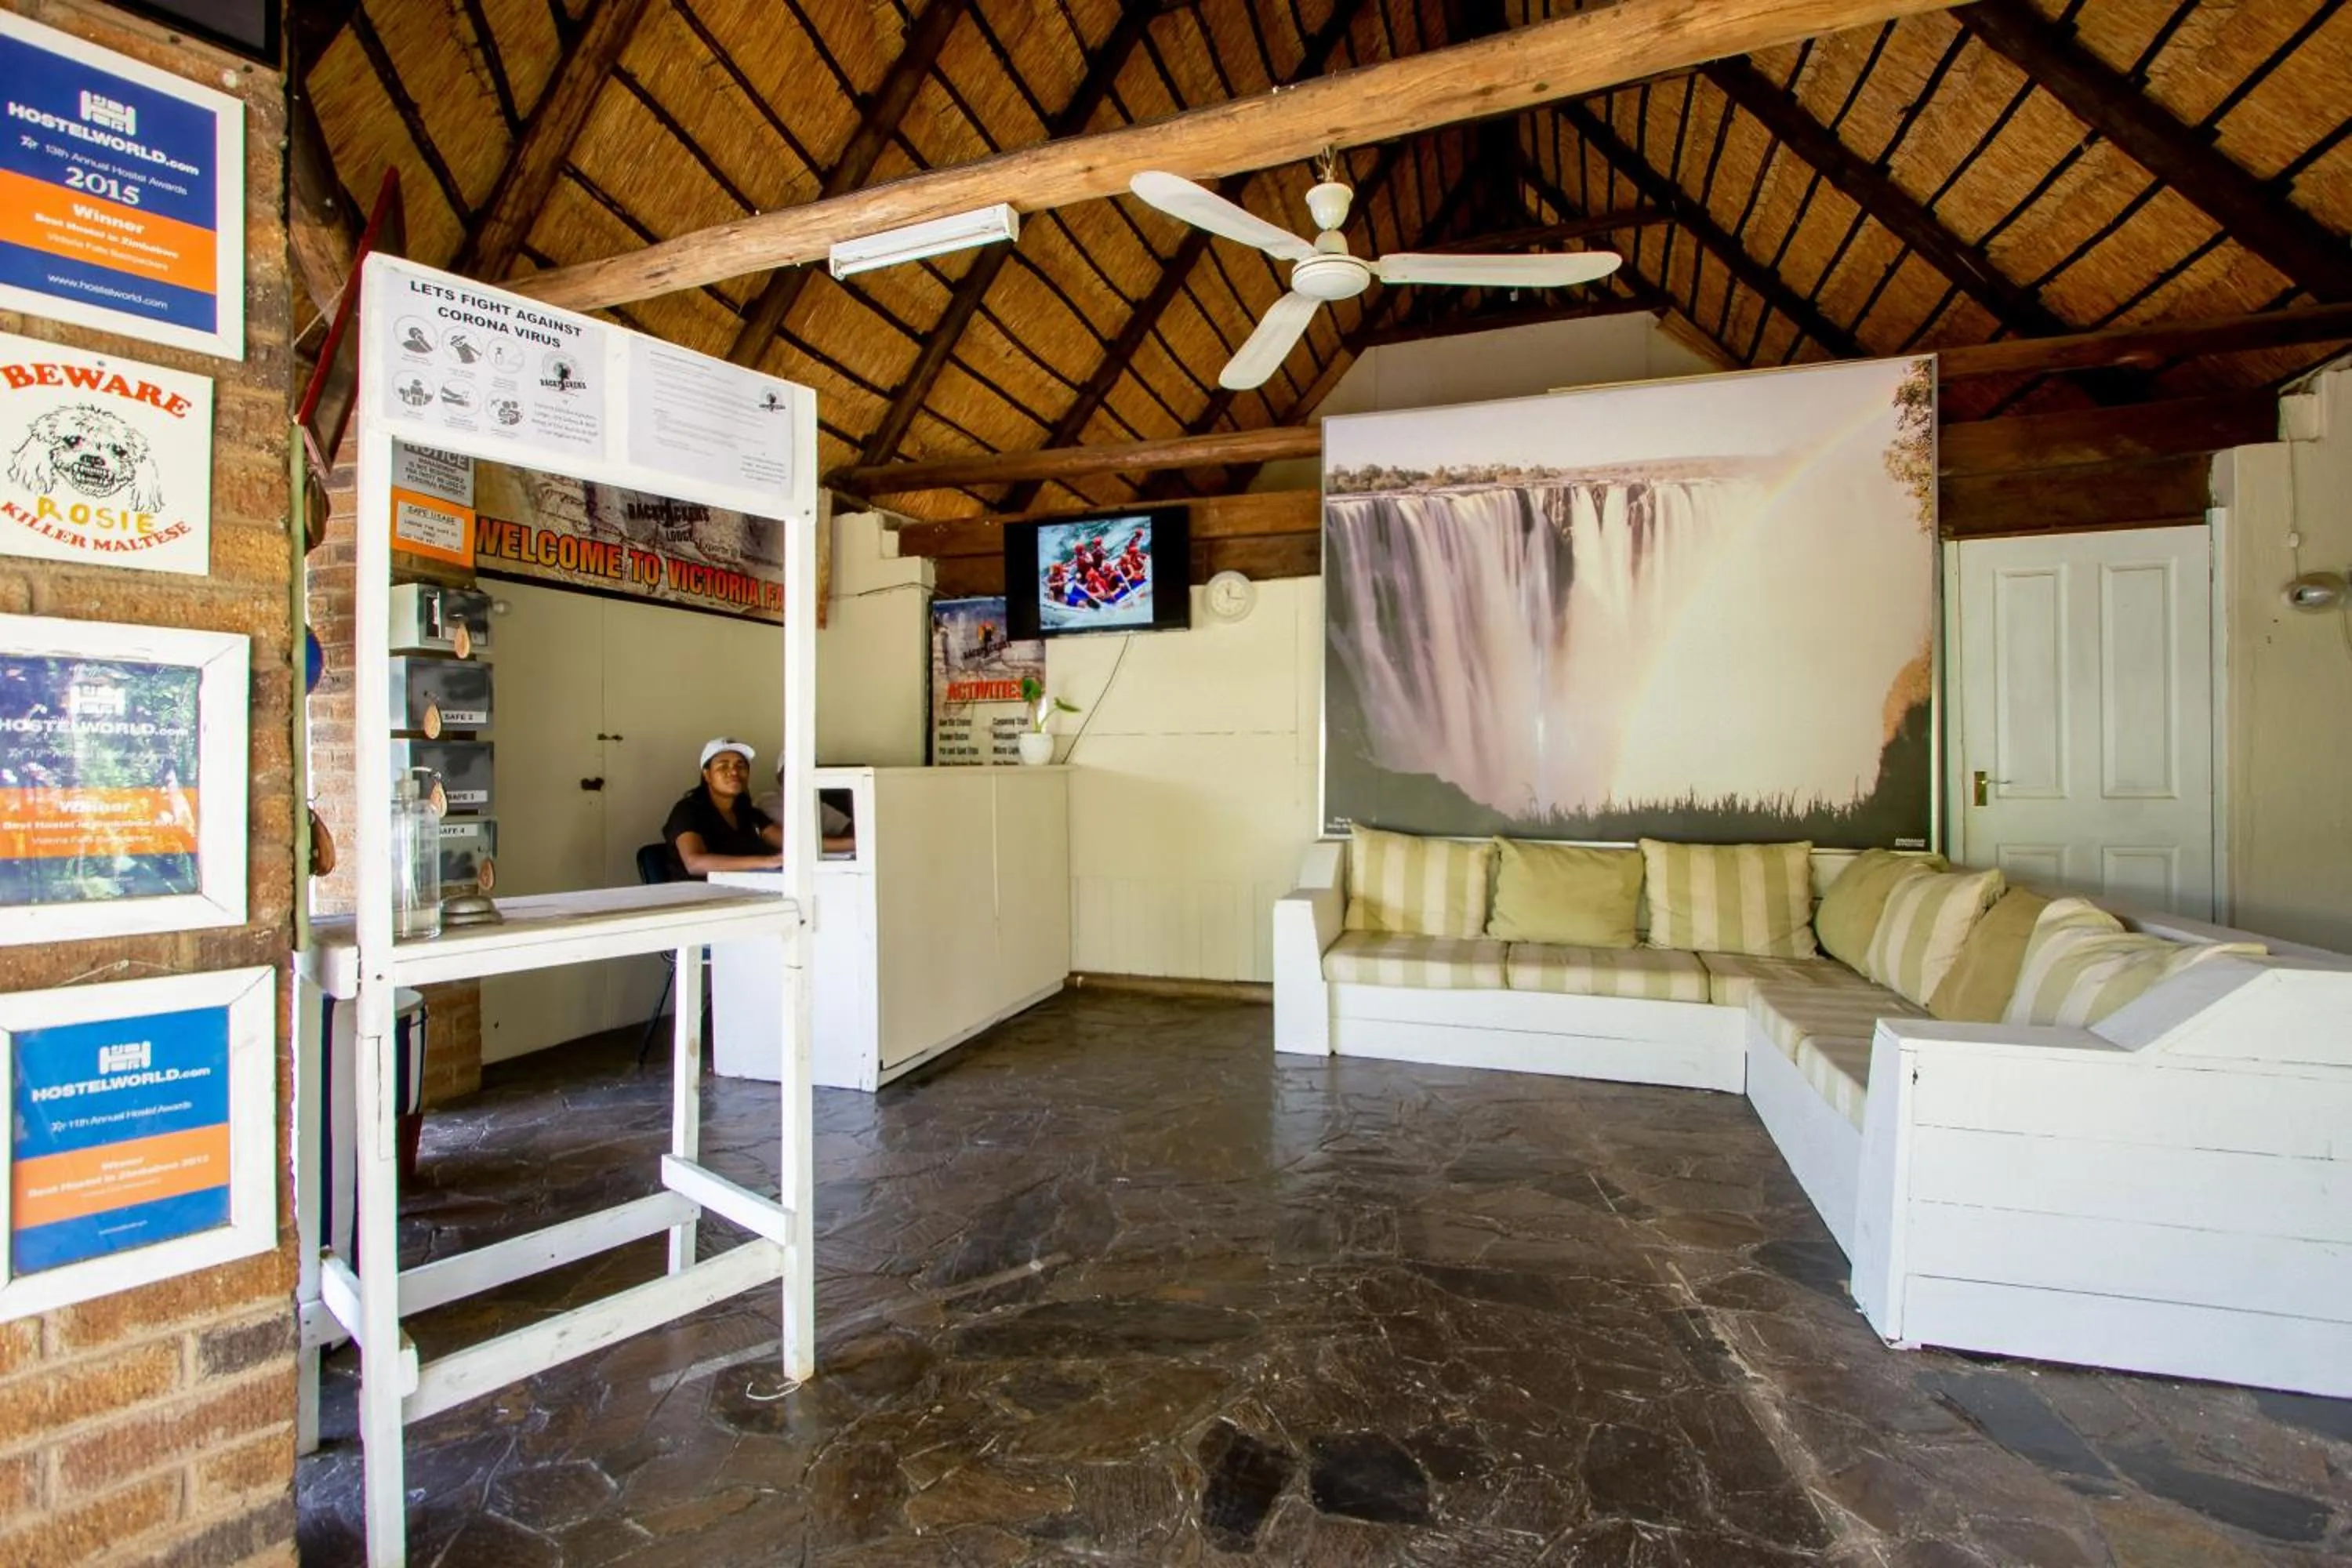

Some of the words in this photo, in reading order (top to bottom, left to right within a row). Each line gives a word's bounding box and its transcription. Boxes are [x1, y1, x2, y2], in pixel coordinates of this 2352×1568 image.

[8, 102, 199, 176] HOSTELWORLD.com
[65, 166, 141, 205] 2015
[71, 152, 110, 172] Annual
[111, 165, 147, 183] Hostel
[148, 176, 188, 196] Awards
[72, 203, 146, 234] Winner
[47, 274, 169, 310] www.hostelworld.com
[409, 280, 456, 301] LETS
[461, 294, 511, 315] FIGHT
[516, 310, 583, 336] AGAINST
[437, 307, 510, 335] CORONA
[514, 325, 562, 348] VIRUS
[0, 364, 193, 419] BEWARE
[1, 501, 86, 548] KILLER
[93, 521, 192, 552] MALTESE
[38, 495, 155, 535] ROSIE
[476, 514, 624, 580] WELCOME
[630, 549, 661, 587] TO
[667, 557, 760, 608] VICTORIA
[0, 717, 189, 737] HOSTELWORLD.com
[31, 1067, 211, 1103] HOSTELWORLD.com
[89, 1112, 125, 1126] Annual
[157, 1101, 193, 1114] Awards
